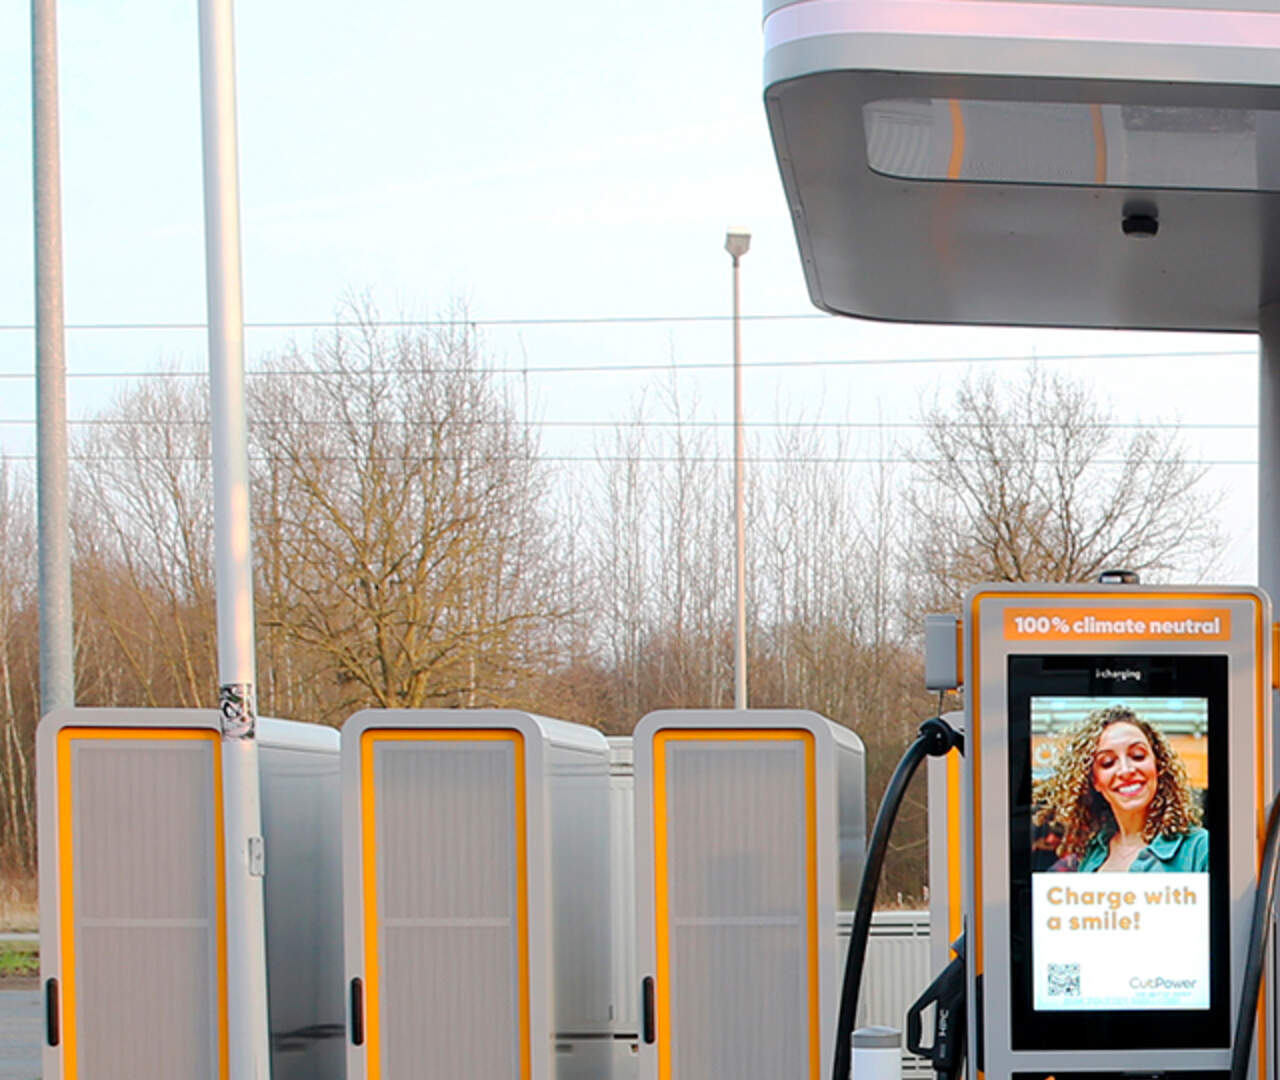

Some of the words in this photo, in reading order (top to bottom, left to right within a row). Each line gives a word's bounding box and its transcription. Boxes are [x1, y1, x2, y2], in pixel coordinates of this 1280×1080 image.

[1014, 616, 1070, 634] 100%
[1072, 616, 1146, 634] climate
[1149, 617, 1220, 634] neutral
[1047, 886, 1137, 910] Charge
[1144, 885, 1197, 905] with
[1047, 917, 1062, 930] a
[1069, 911, 1141, 931] smile!
[1129, 976, 1198, 989] CutPower
